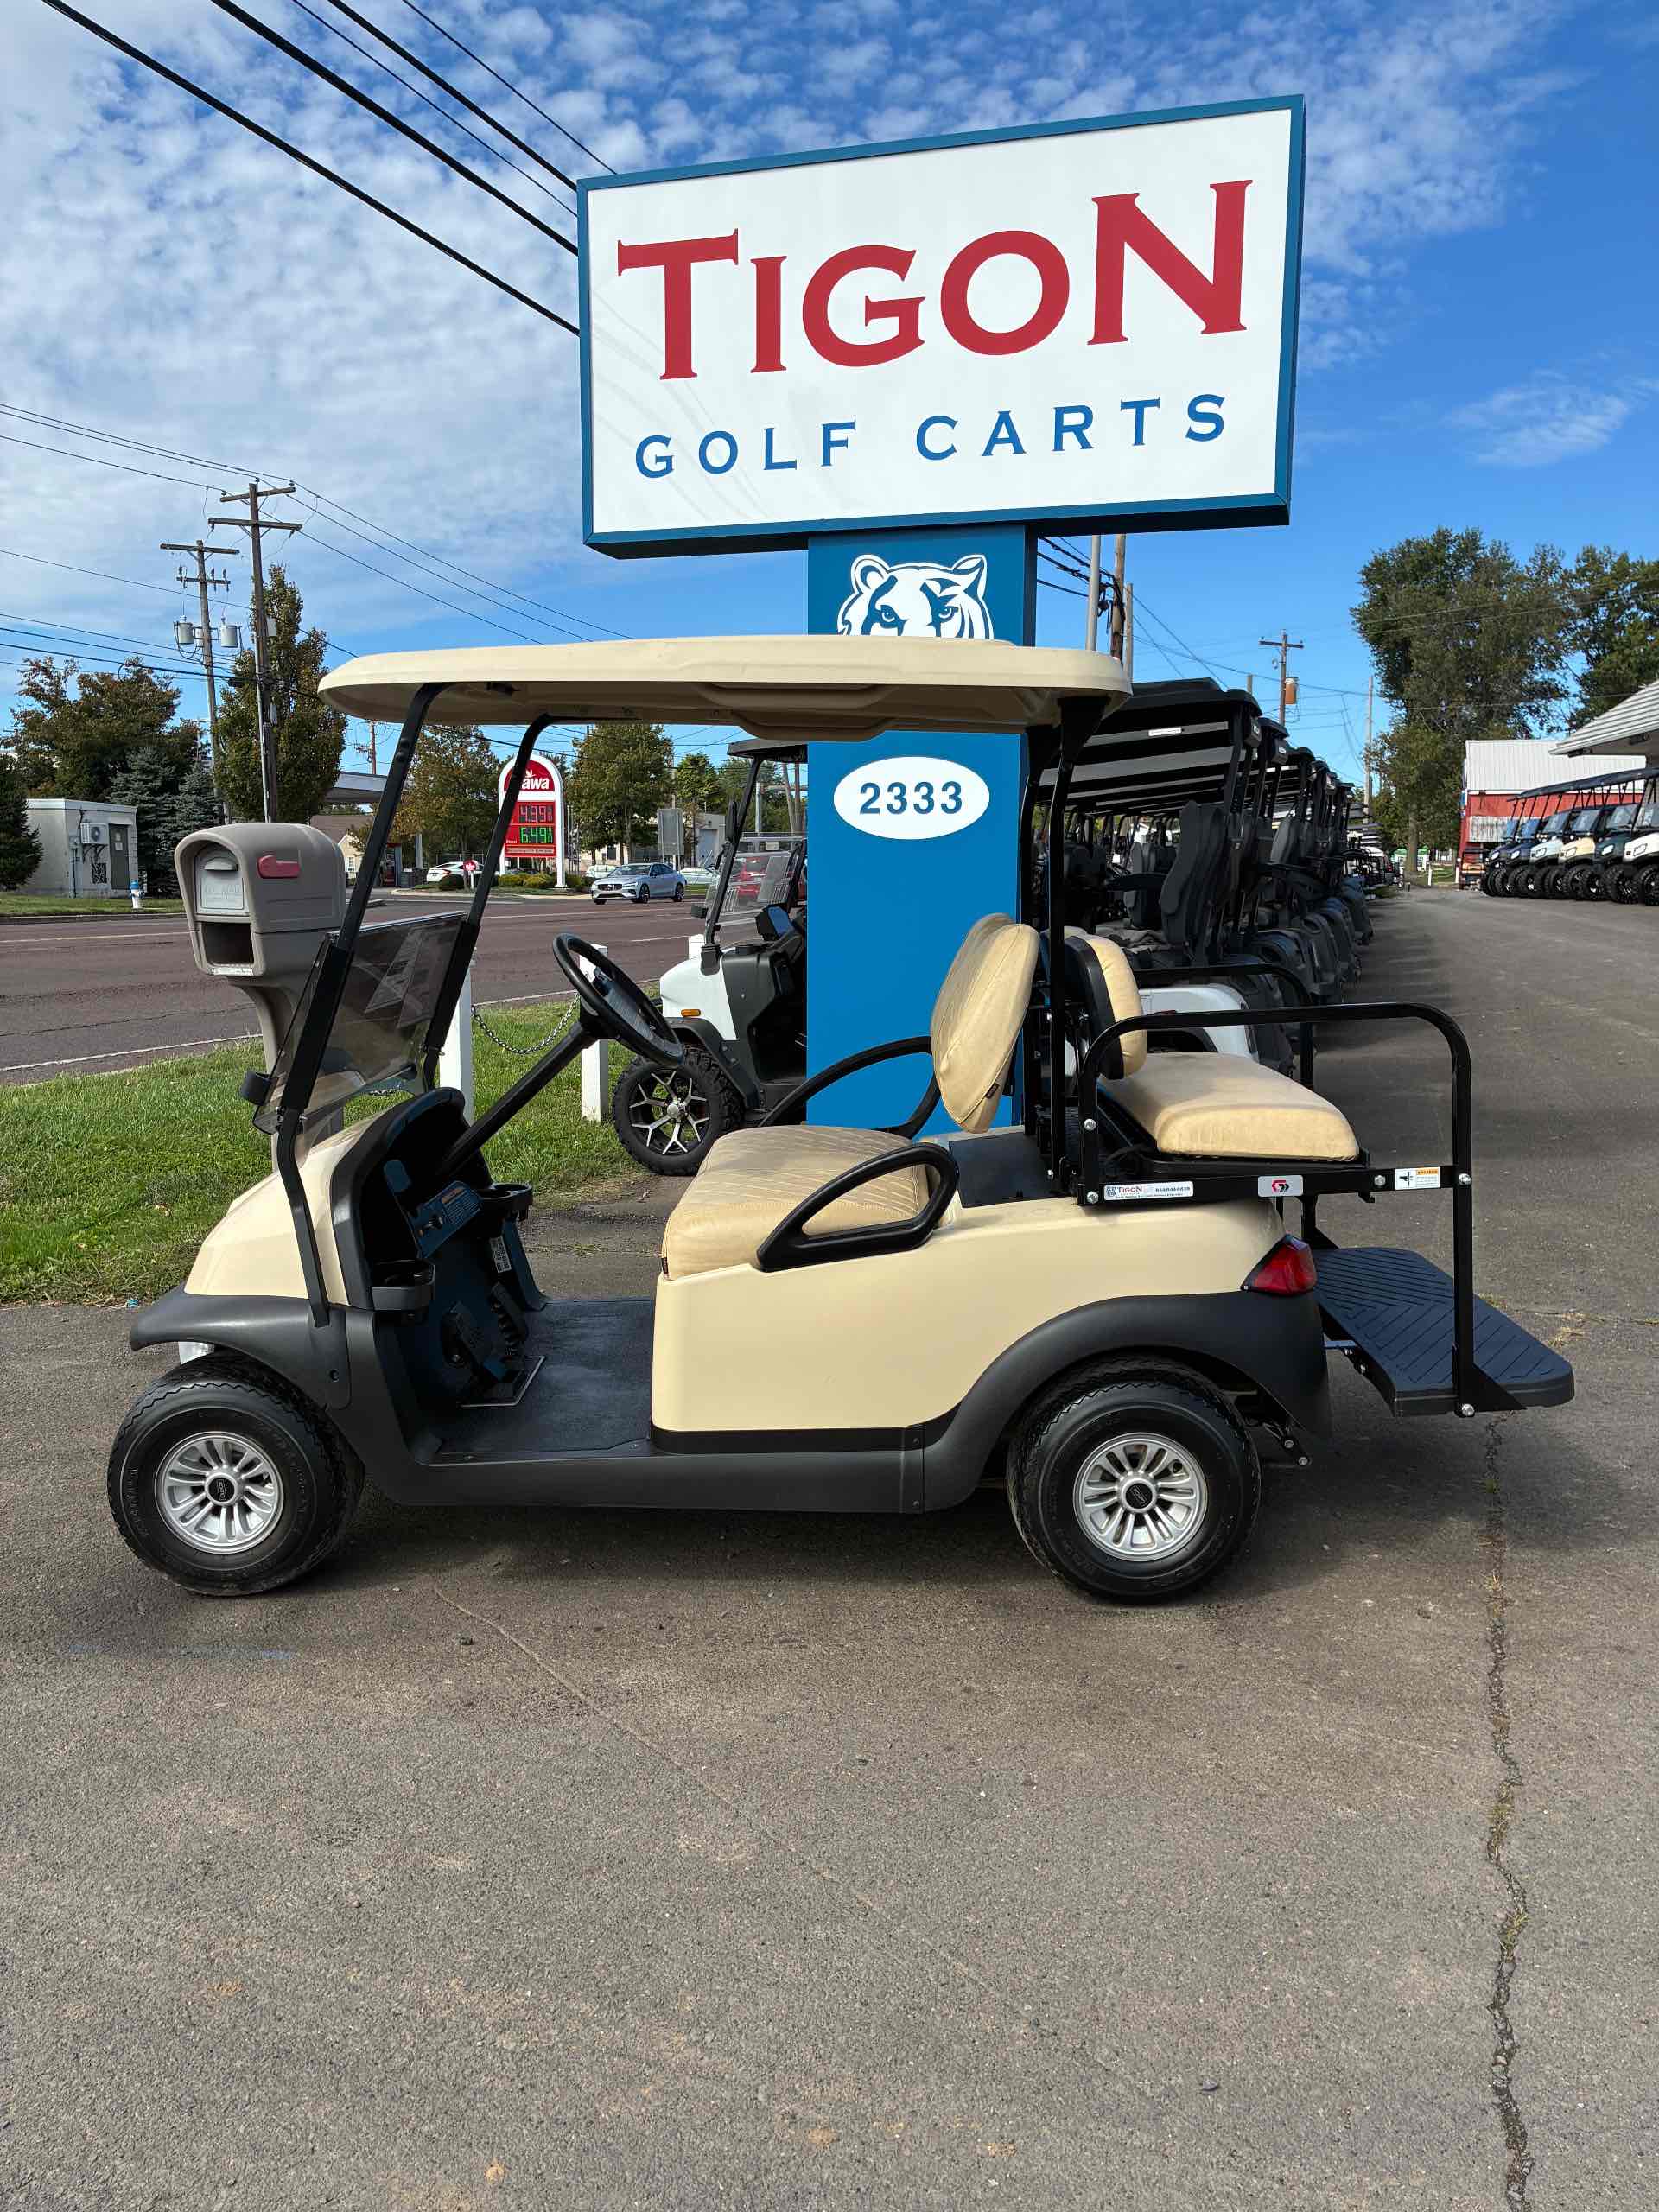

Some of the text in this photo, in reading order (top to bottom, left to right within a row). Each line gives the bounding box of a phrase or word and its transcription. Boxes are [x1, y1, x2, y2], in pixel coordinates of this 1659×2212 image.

[617, 179, 1254, 380] TIGON
[635, 393, 1226, 478] GOLF CARTS
[521, 777, 550, 790] awa
[860, 781, 963, 815] 2333
